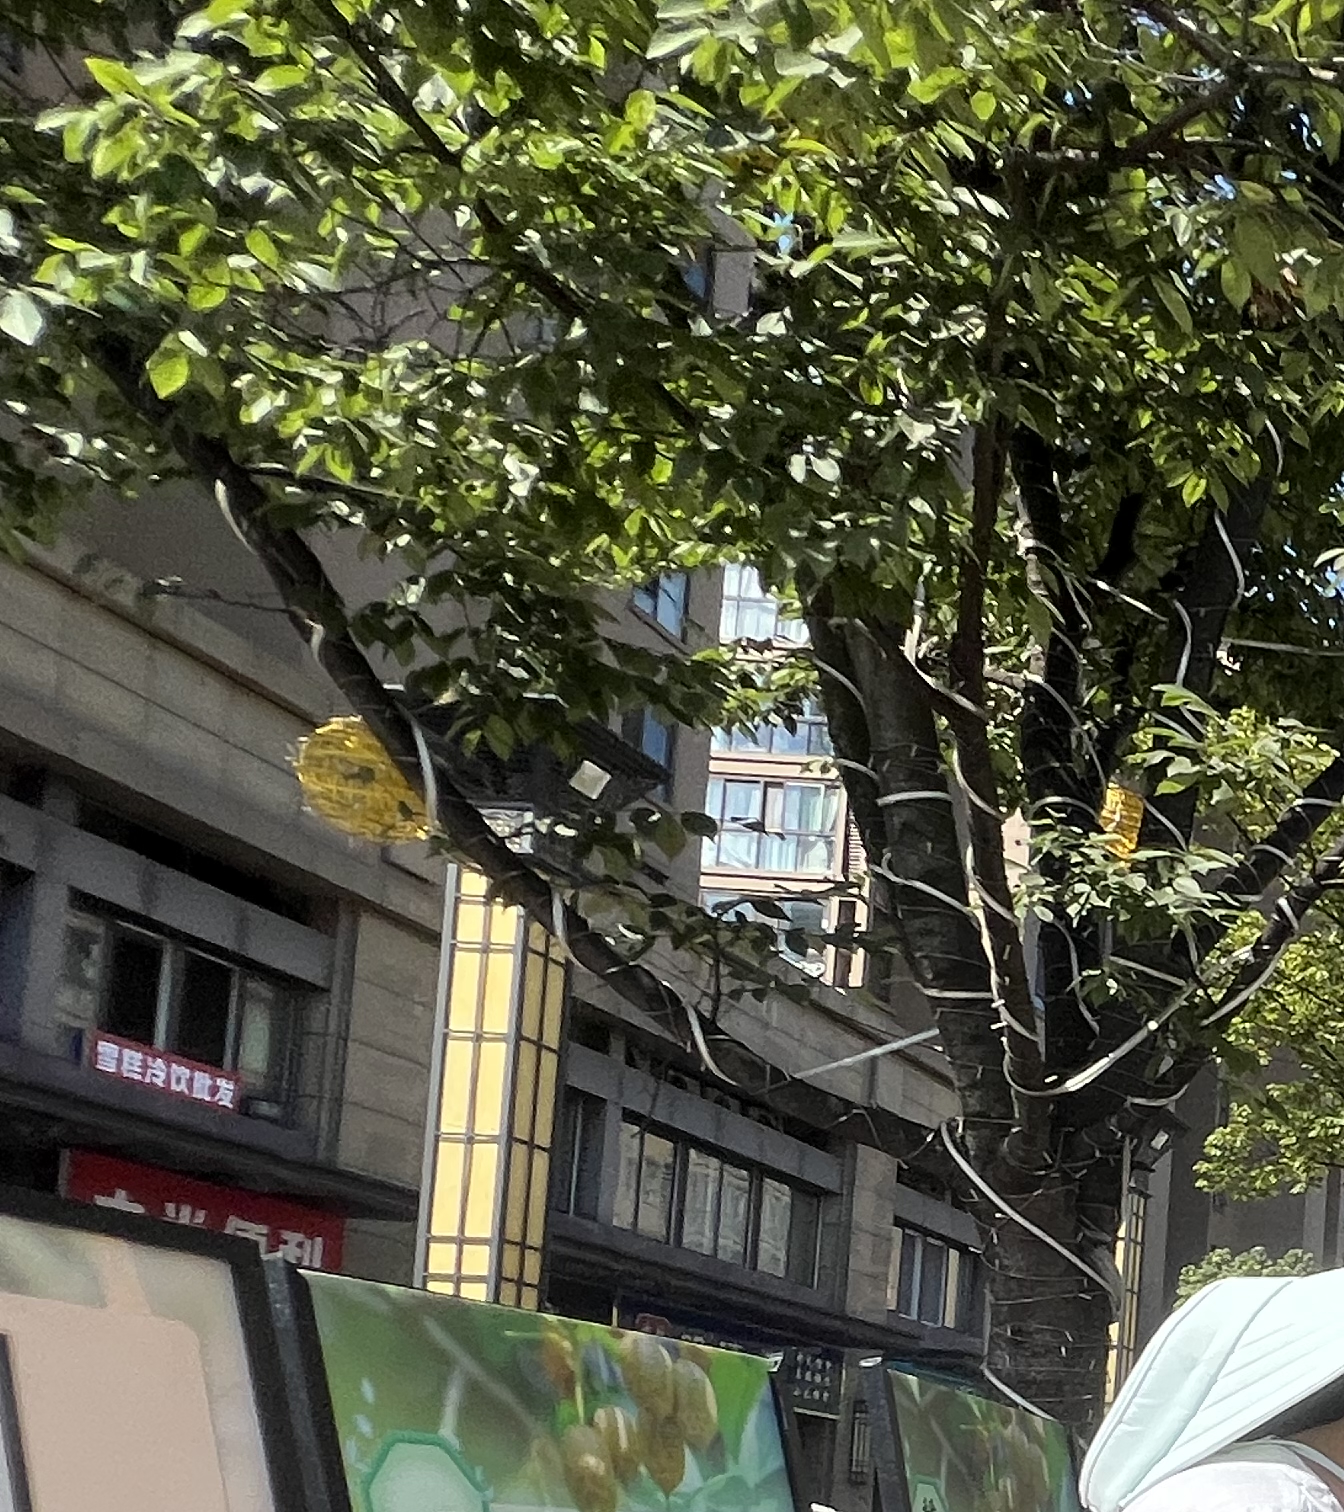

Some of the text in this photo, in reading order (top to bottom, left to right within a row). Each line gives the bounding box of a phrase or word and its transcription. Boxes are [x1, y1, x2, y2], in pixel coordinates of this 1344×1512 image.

[95, 1040, 235, 1109] 雪糕冷饮批发
